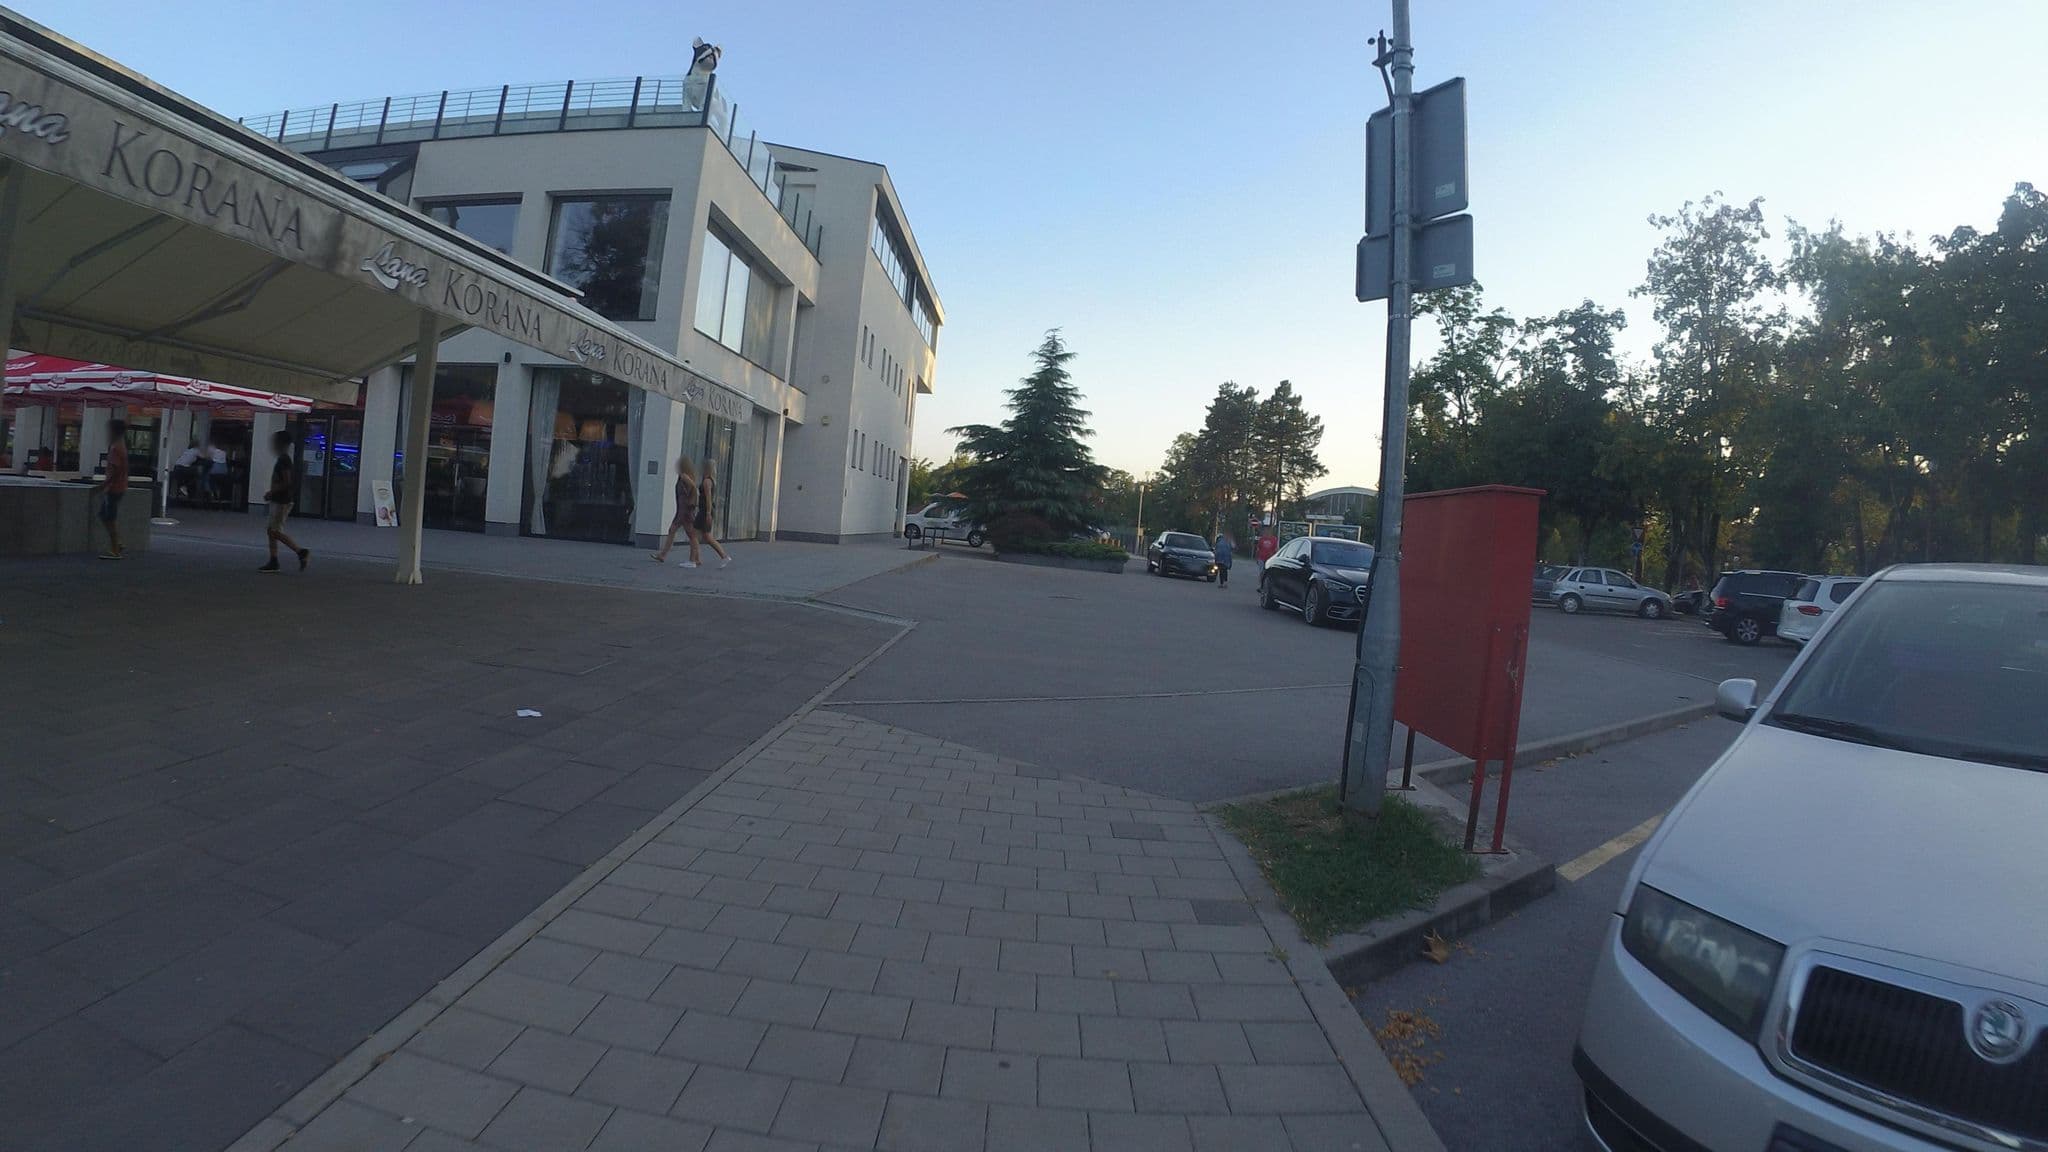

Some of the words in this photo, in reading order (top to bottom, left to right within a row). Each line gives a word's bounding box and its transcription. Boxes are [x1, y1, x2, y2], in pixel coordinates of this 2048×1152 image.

[101, 120, 304, 251] KORANA
[360, 240, 429, 290] Lana
[442, 268, 544, 343] KORANA
[613, 344, 668, 391] KORANA
